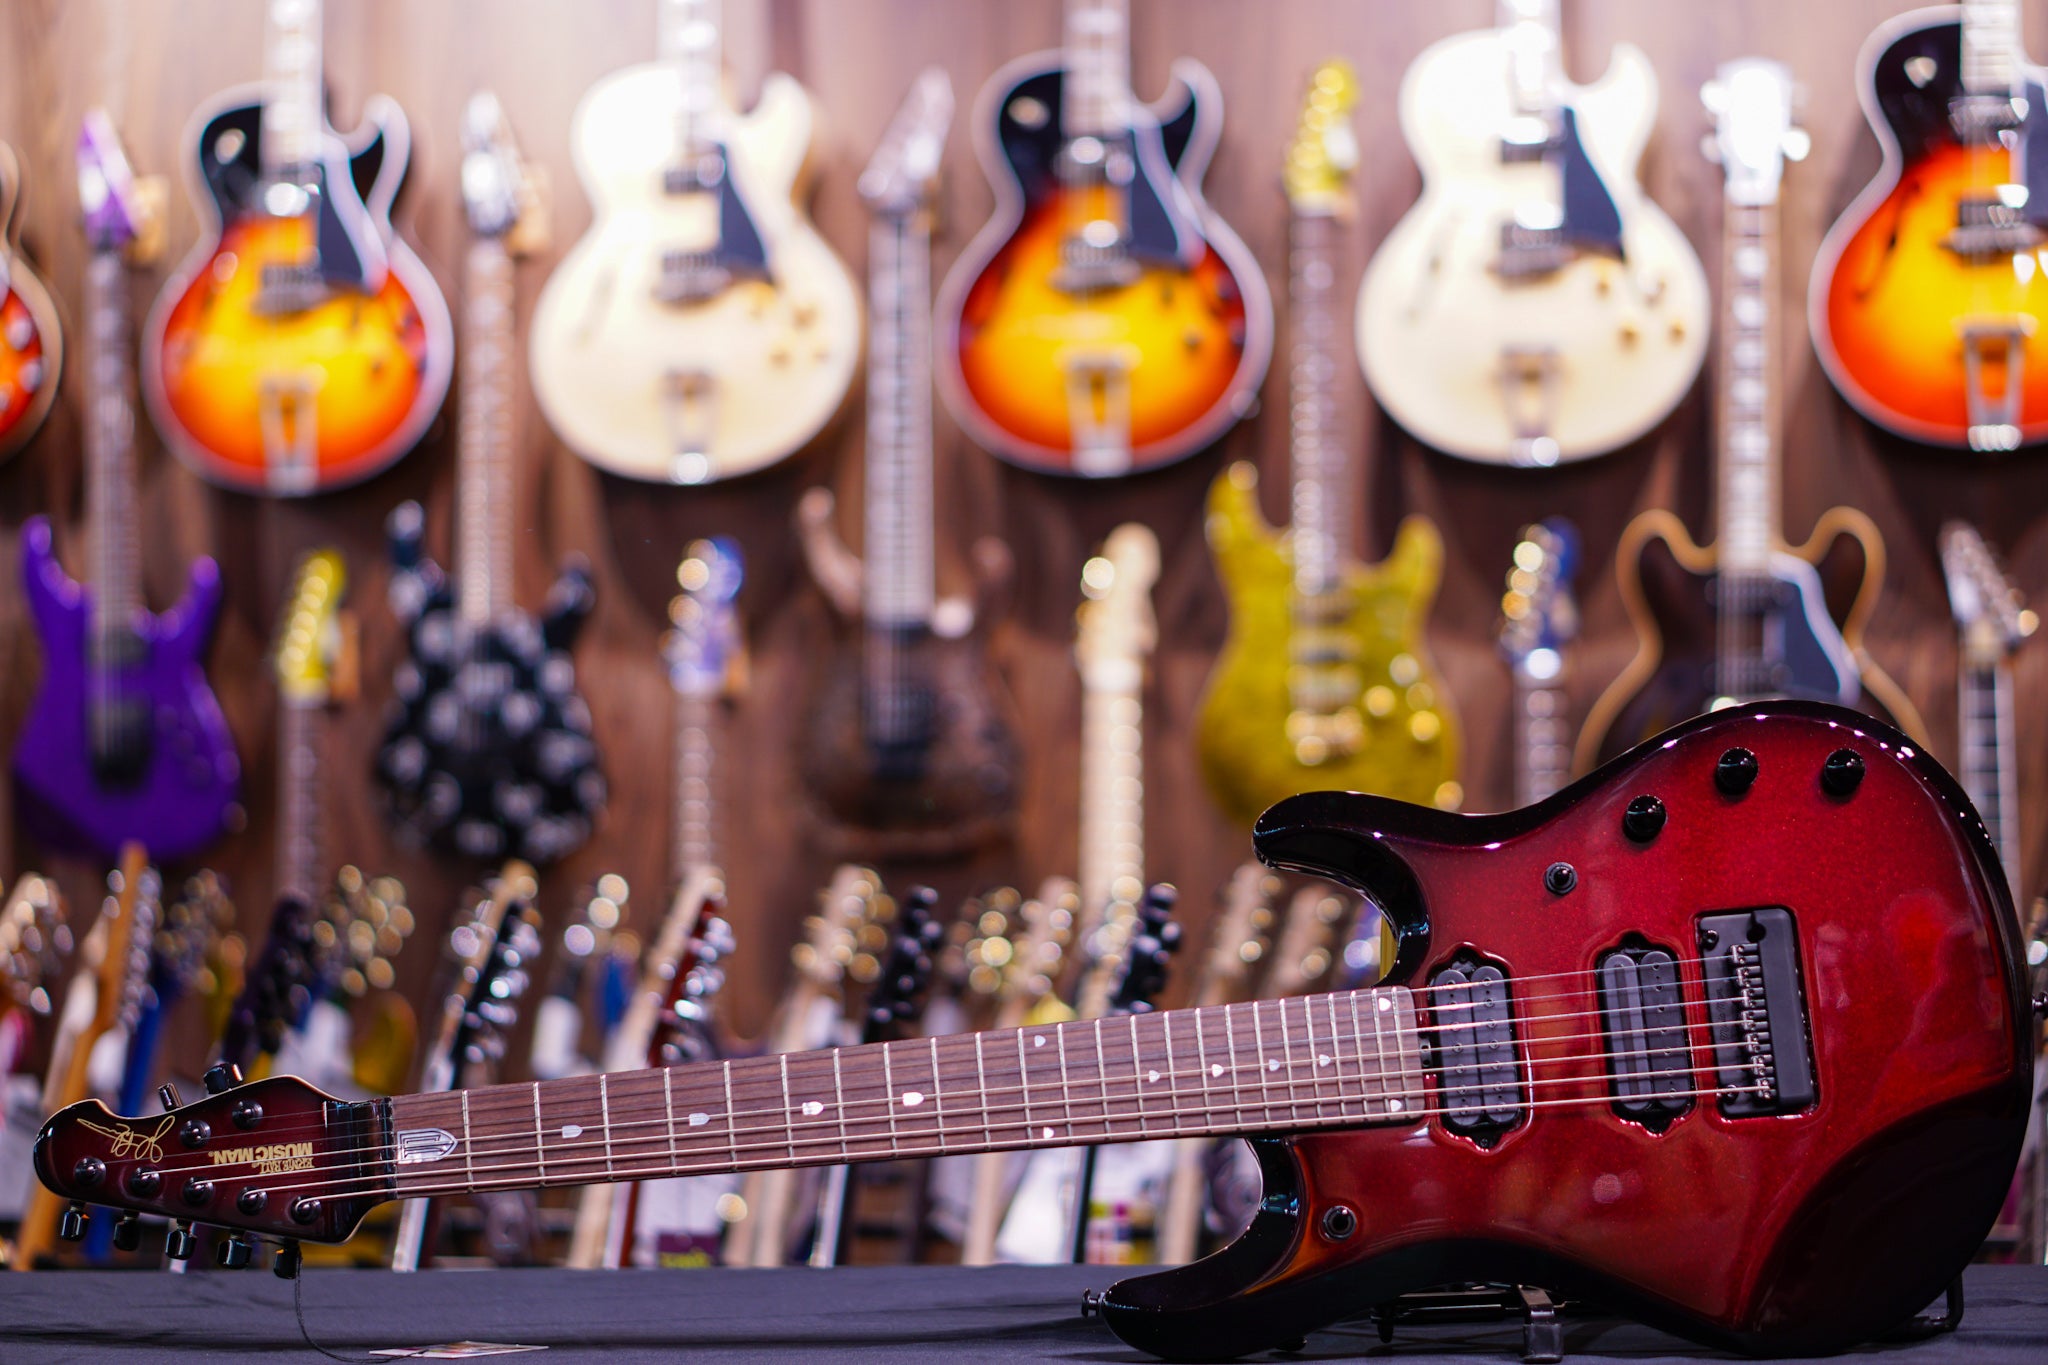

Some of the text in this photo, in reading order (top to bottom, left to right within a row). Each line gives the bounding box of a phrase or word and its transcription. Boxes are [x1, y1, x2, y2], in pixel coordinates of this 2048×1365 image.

[255, 1142, 313, 1160] MUSIC
[259, 1157, 315, 1175] ERNIE BALL
